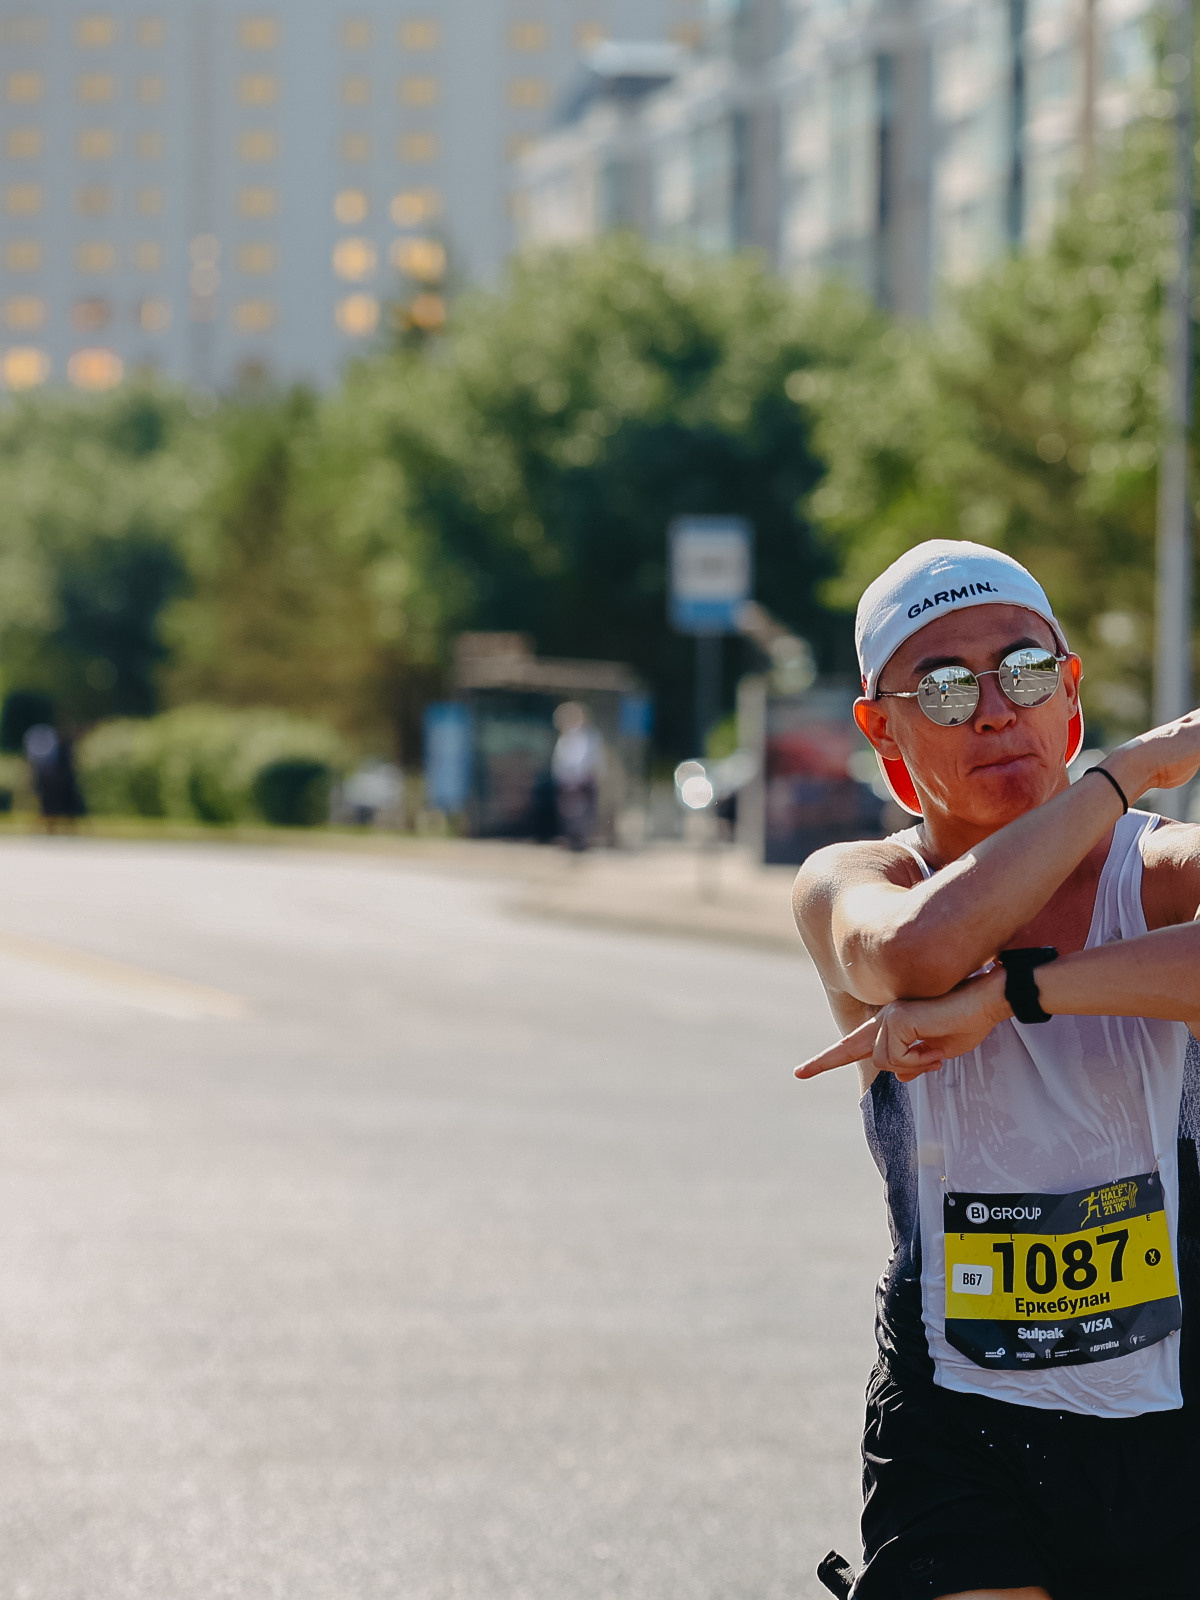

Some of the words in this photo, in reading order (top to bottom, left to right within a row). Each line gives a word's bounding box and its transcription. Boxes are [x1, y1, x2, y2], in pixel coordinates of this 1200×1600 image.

[1100, 1188, 1123, 1202] HALF
[990, 1206, 1042, 1221] GROUP
[992, 1228, 1130, 1295] 1087
[962, 1272, 983, 1286] B67
[1015, 1291, 1111, 1318] Еркебулан
[1079, 1317, 1114, 1334] VISA
[1017, 1327, 1065, 1342] Sulpak
